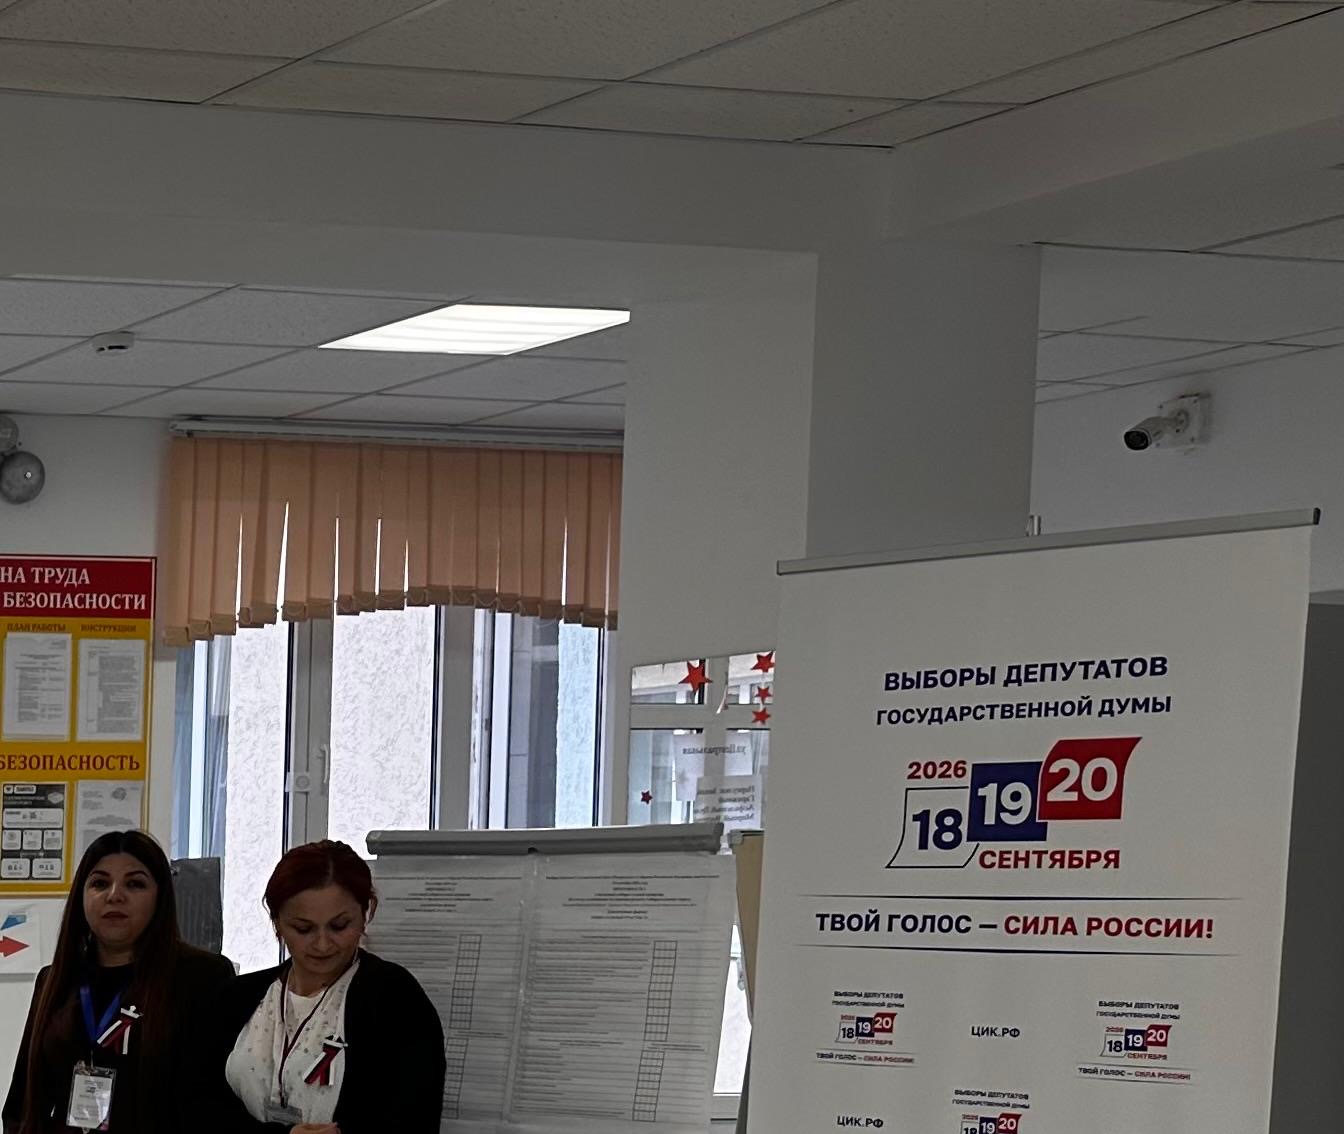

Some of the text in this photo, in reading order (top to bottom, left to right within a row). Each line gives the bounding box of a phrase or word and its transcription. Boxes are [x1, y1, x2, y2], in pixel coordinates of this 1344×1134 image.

[31, 566, 91, 586] ТРУДА
[3, 592, 146, 611] БЕЗОПАСНОСТИ
[884, 656, 1169, 691] ВЫБОРЫ ДЕПУТАТОВ
[876, 696, 1172, 726] ГОСУДАРСТВЕННОЙ ДУМЫ
[906, 760, 967, 780] 2026
[912, 757, 1118, 851] 18 19 20
[979, 849, 1121, 870] СЕНТЯБРЯ
[816, 909, 880, 934] ТВОЙ
[887, 914, 972, 934] ГОЛОС
[1004, 915, 1079, 937] СИЛА
[1086, 917, 1214, 939] РОССИИ!
[841, 1016, 892, 1039] 18 19 20
[971, 1025, 1021, 1038] ЦИК.РФ
[1107, 1029, 1167, 1053] 18 19 20
[837, 1115, 884, 1128] ЦИК.РФ
[981, 1122, 995, 1134] 19
[998, 1118, 1017, 1131] 20
